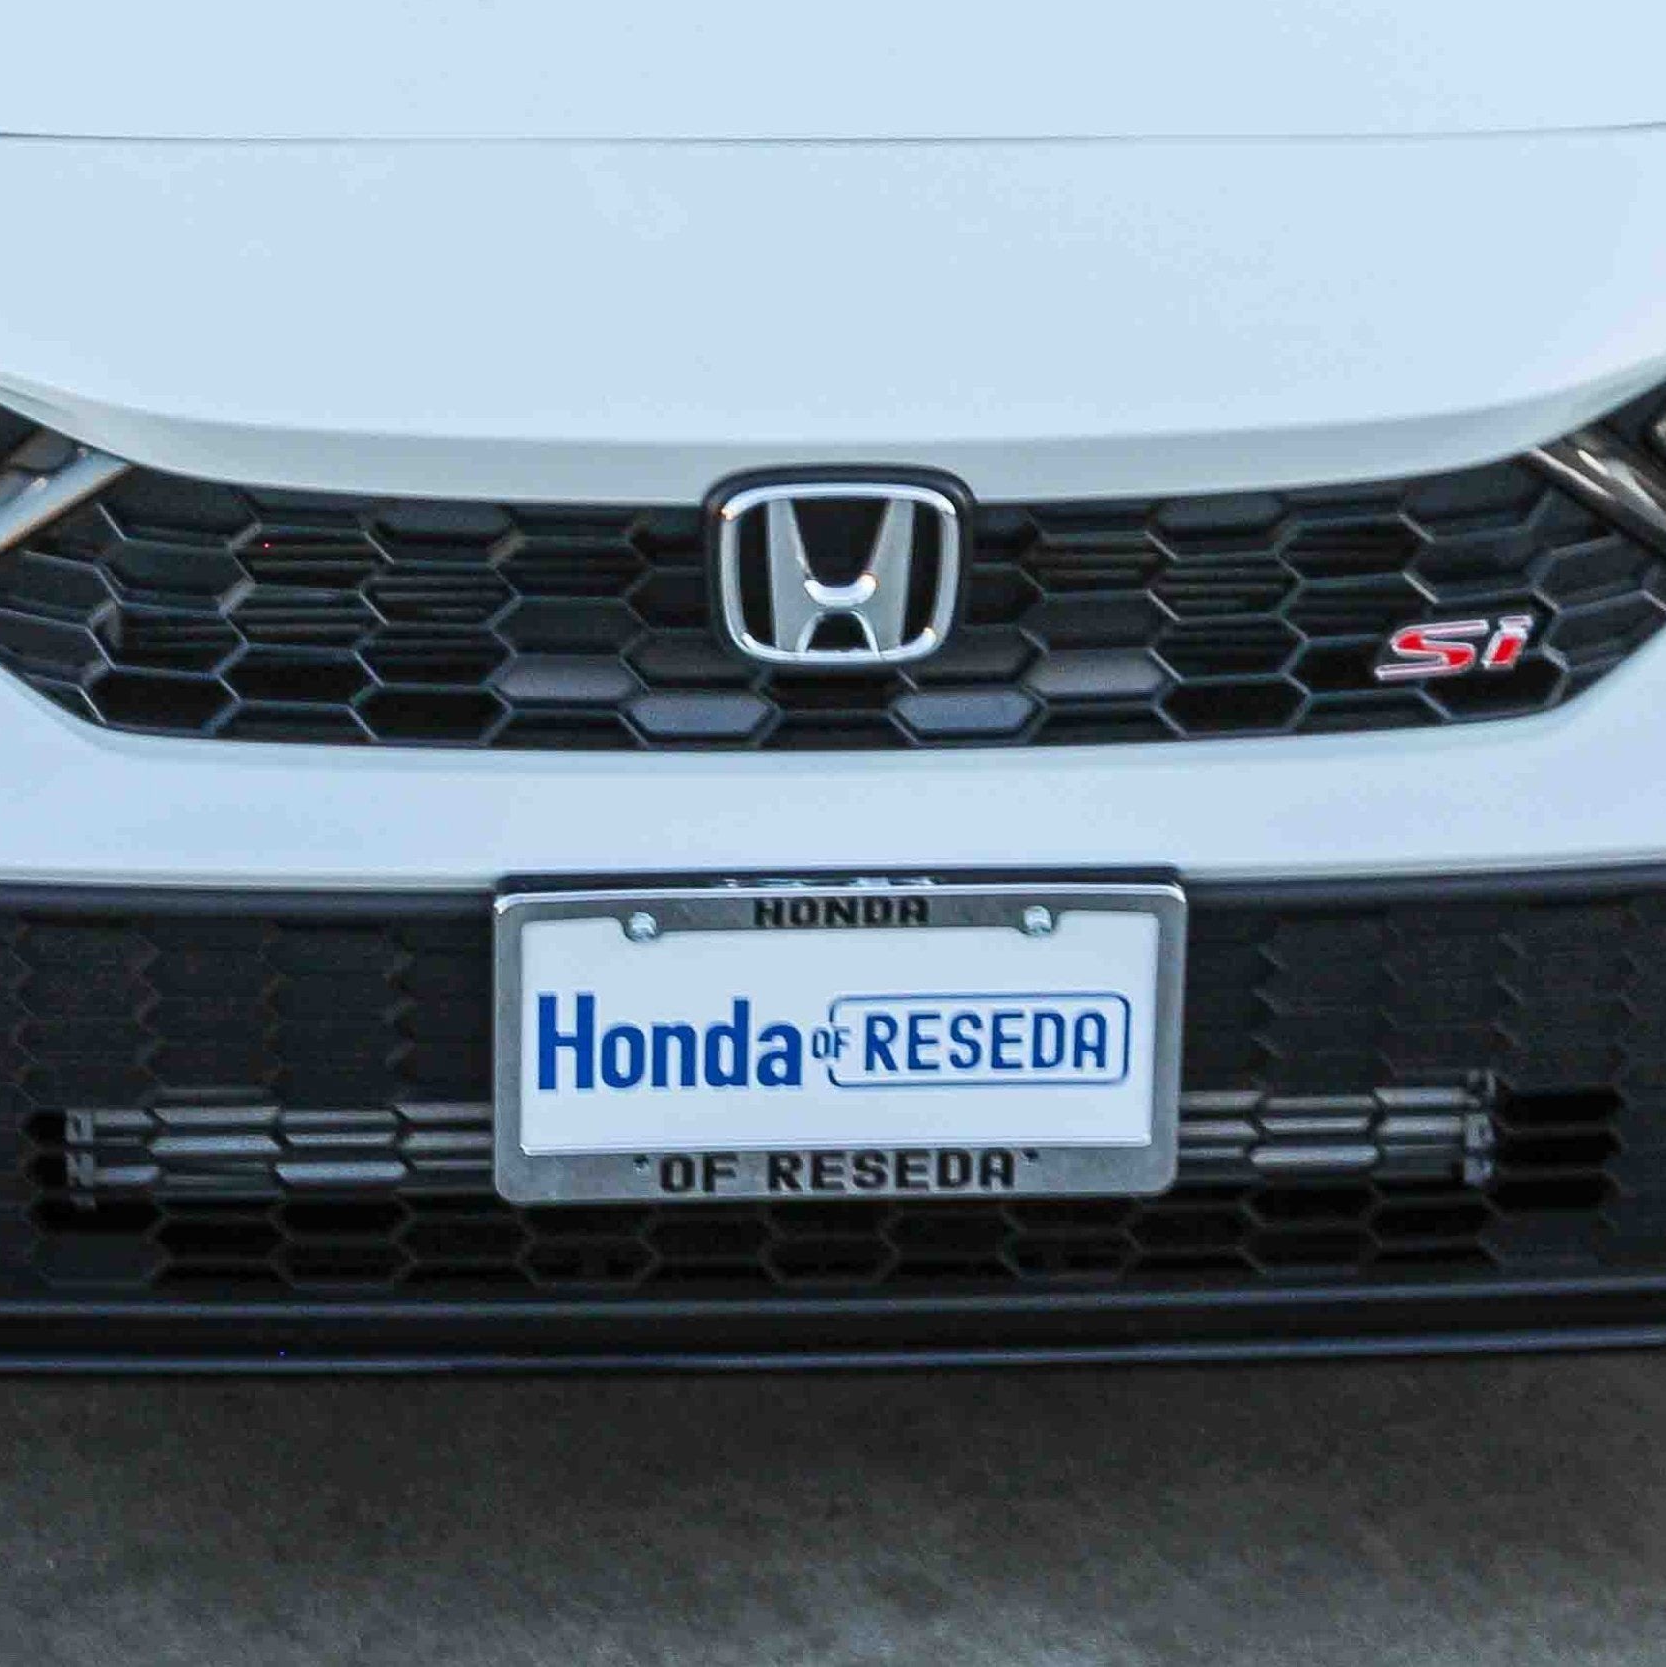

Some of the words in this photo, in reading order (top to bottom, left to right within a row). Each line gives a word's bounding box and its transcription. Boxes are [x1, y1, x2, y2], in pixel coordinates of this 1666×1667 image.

[1374, 615, 1533, 681] Si
[753, 894, 931, 929] HONDA
[536, 992, 804, 1090] Honda
[811, 1026, 851, 1062] OF
[863, 1009, 1108, 1072] RESEDA
[659, 1150, 739, 1193] OF
[766, 1147, 1017, 1193] RESEDA
